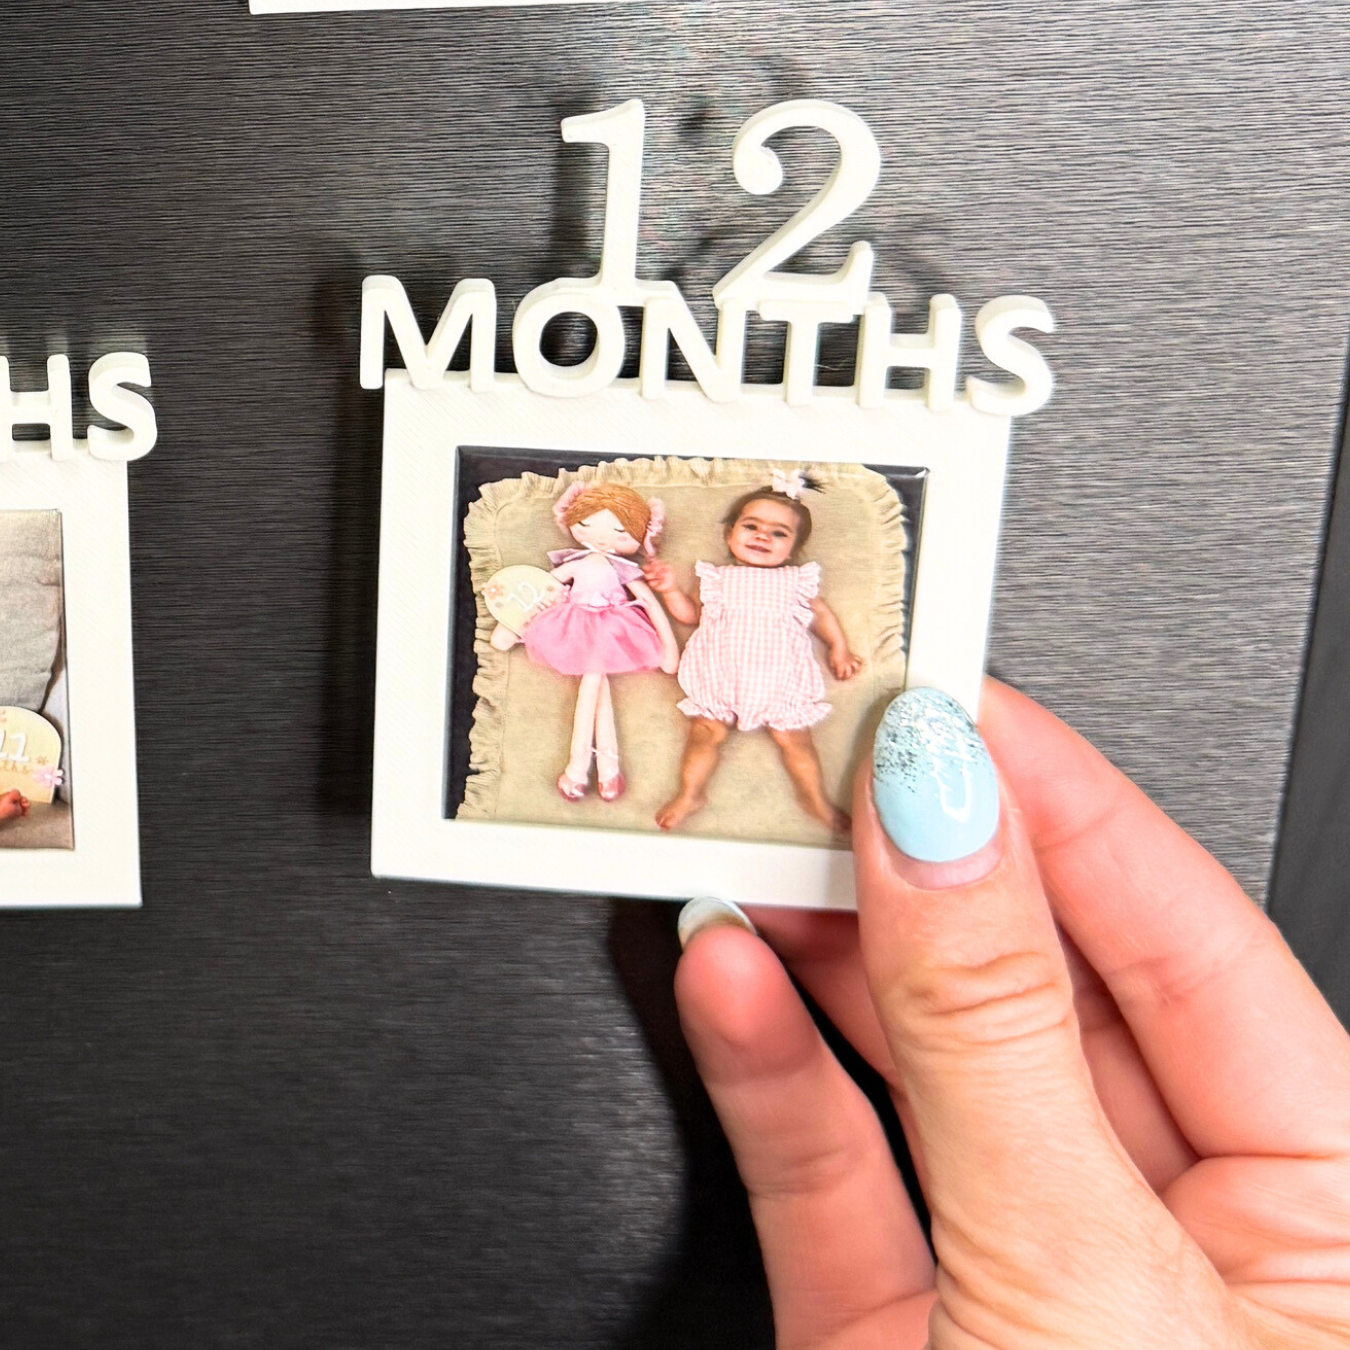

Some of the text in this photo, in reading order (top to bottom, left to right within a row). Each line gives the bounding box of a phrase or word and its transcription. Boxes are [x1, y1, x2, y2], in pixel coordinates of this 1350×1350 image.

[560, 98, 881, 312] 12
[359, 275, 1056, 416] MONTHS
[506, 581, 545, 613] 12
